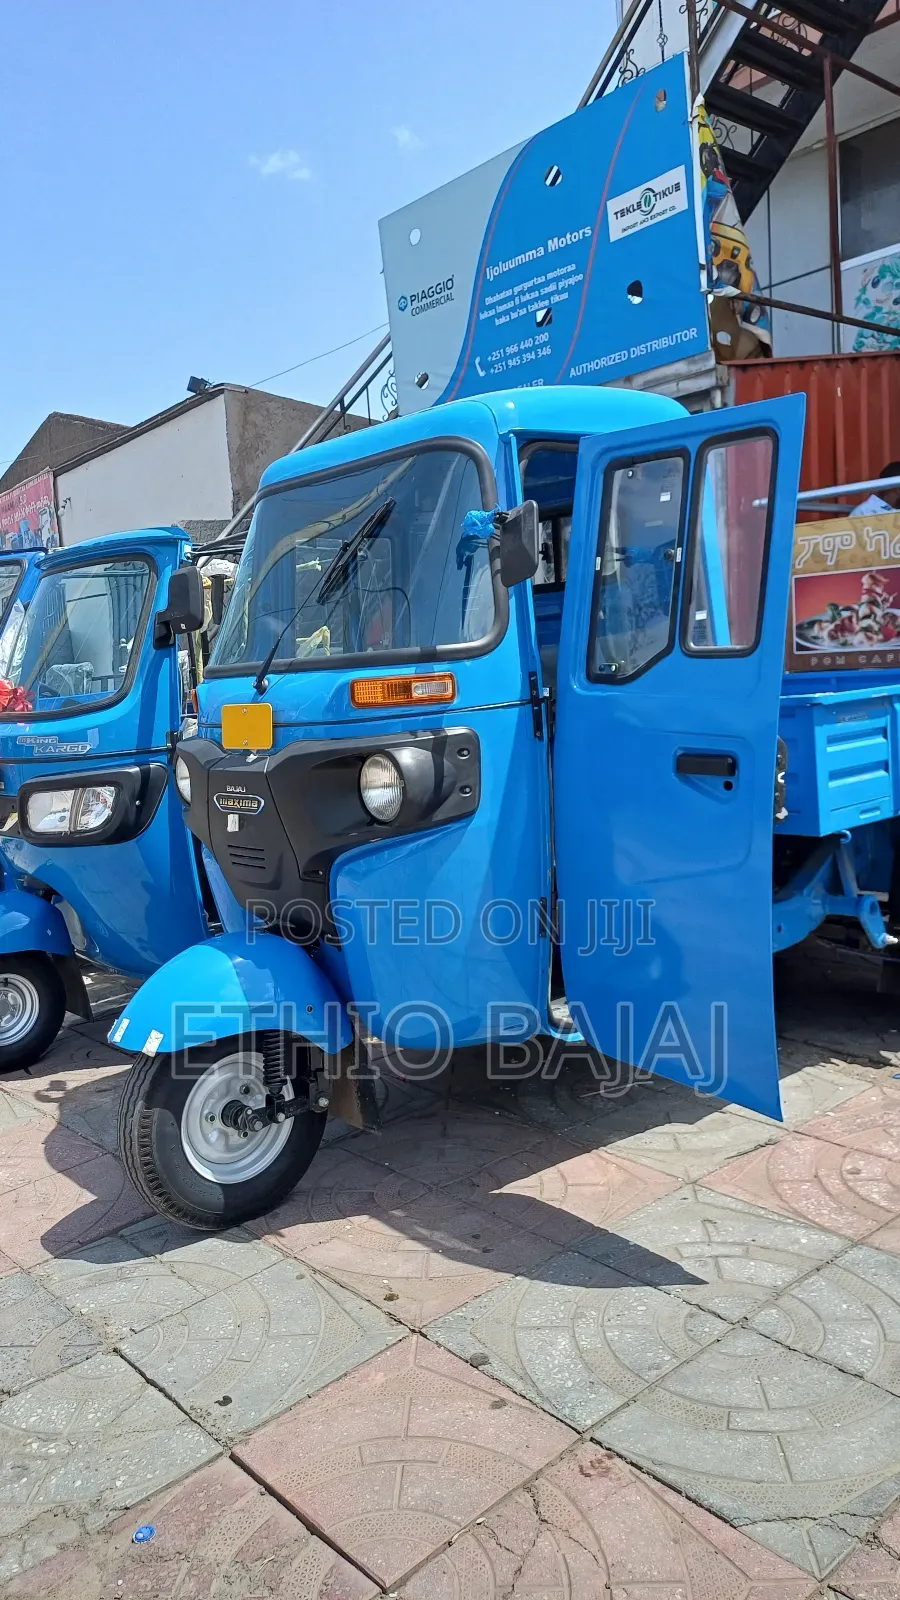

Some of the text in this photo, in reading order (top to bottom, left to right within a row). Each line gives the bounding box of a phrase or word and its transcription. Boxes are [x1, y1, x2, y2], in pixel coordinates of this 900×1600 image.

[613, 181, 681, 220] TEKLE TIKUE
[650, 208, 668, 220] EXPORT
[486, 225, 592, 281] Ijoluumma Motors
[410, 277, 454, 306] PIAGGIO
[513, 275, 546, 295] gurgurtaa
[546, 263, 576, 280] motoraa
[410, 292, 454, 316] COMMERCIAL
[487, 348, 504, 362] +251
[520, 337, 534, 350] 440
[534, 332, 550, 345] 200
[490, 344, 552, 374] +251 945 394 346
[568, 327, 698, 378] AUTHORIZED DISTRIBUTOR
[810, 653, 900, 666] POM CAF
[34, 744, 91, 754] KARGO
[220, 798, 258, 810] maxima
